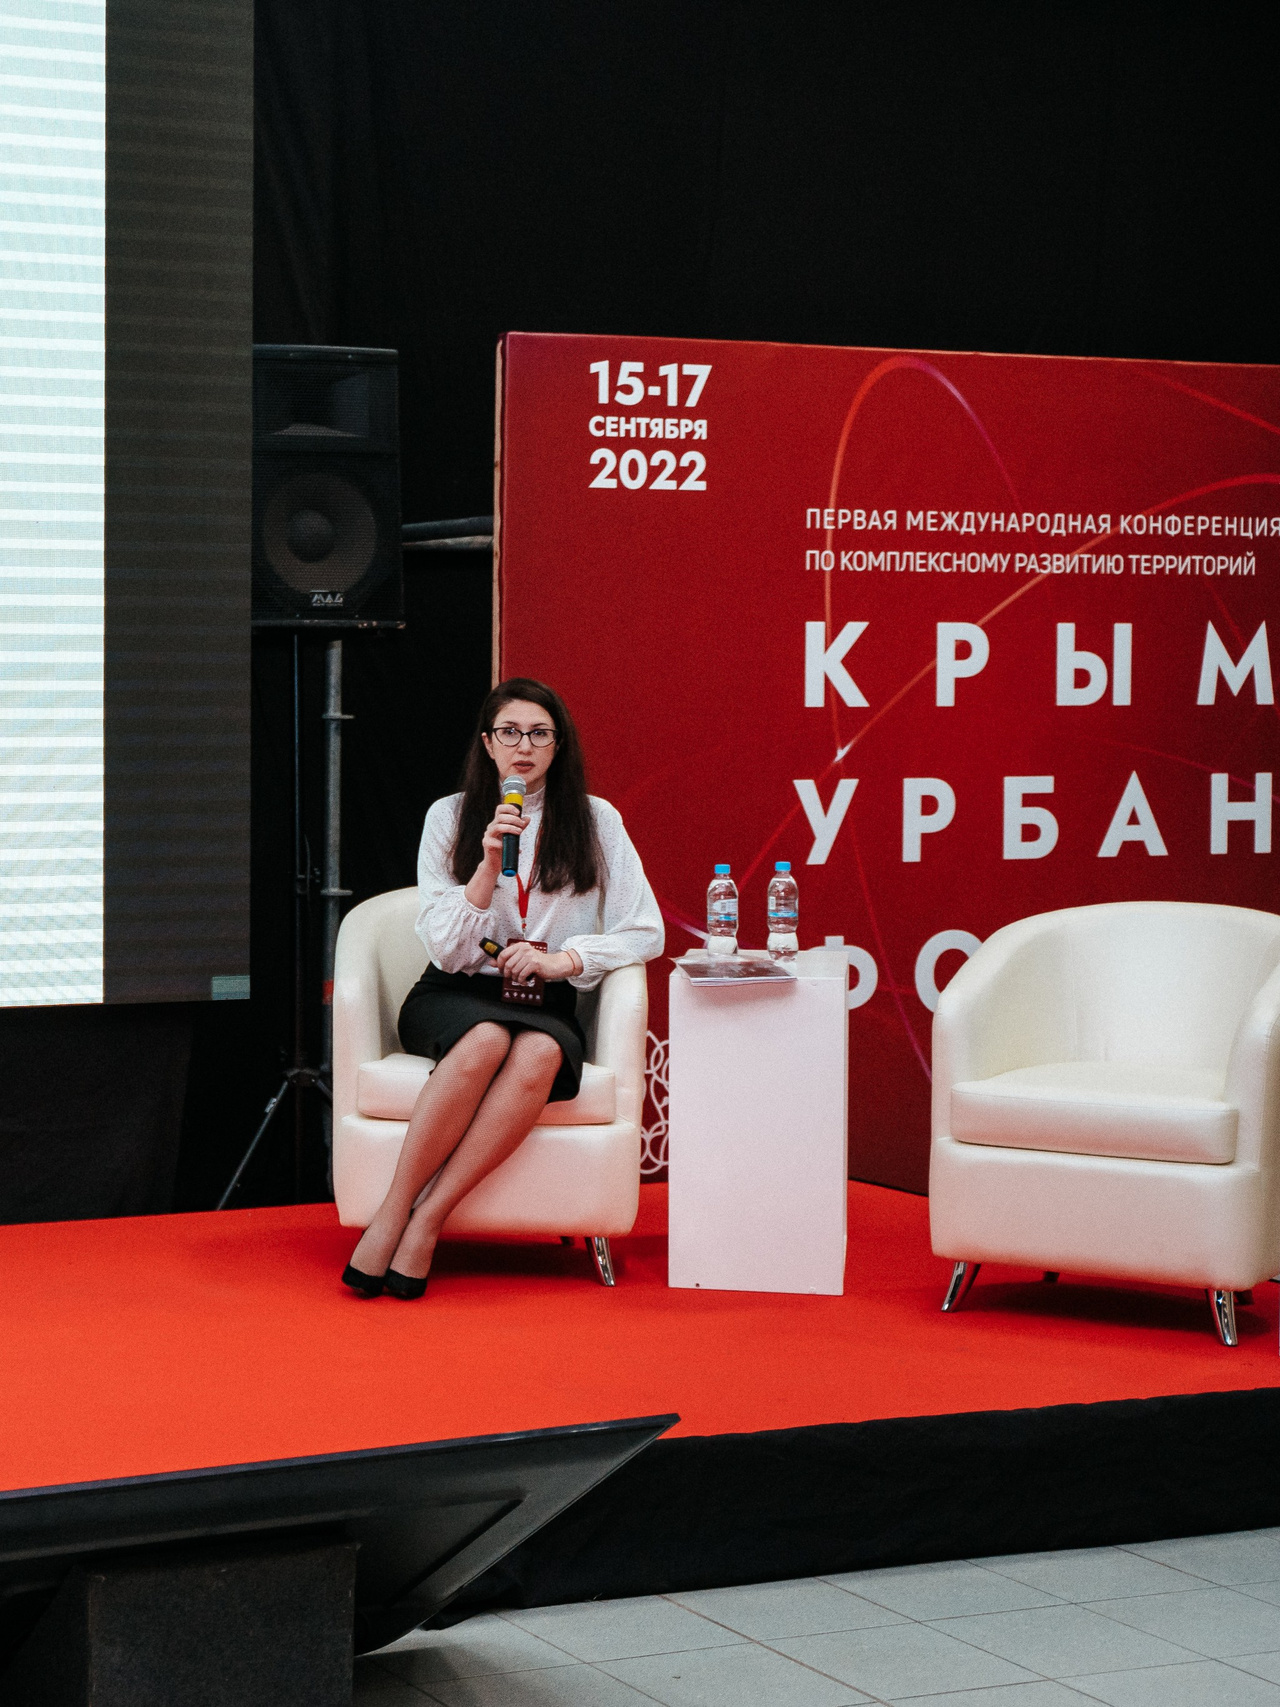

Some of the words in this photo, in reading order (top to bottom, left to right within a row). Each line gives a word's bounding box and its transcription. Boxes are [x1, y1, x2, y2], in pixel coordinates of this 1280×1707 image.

[589, 360, 713, 408] 15-17
[588, 415, 708, 440] СЕНТЯБРЯ
[588, 448, 708, 491] 2022
[806, 508, 897, 531] ПЕРВАЯ
[906, 511, 1111, 536] МЕЖДУНАРОДНАЯ
[1120, 514, 1280, 539] КОНФЕРЕНЦИЯ
[805, 550, 835, 571] ПО
[840, 550, 1011, 574] КОМПЛЕКСНОМУ
[1015, 553, 1124, 575] РАЗВИТИЮ
[1128, 551, 1256, 576] ТЕРРИТОРИЙ
[804, 620, 1275, 708] КРЫМ
[793, 770, 1272, 865] УРБАН
